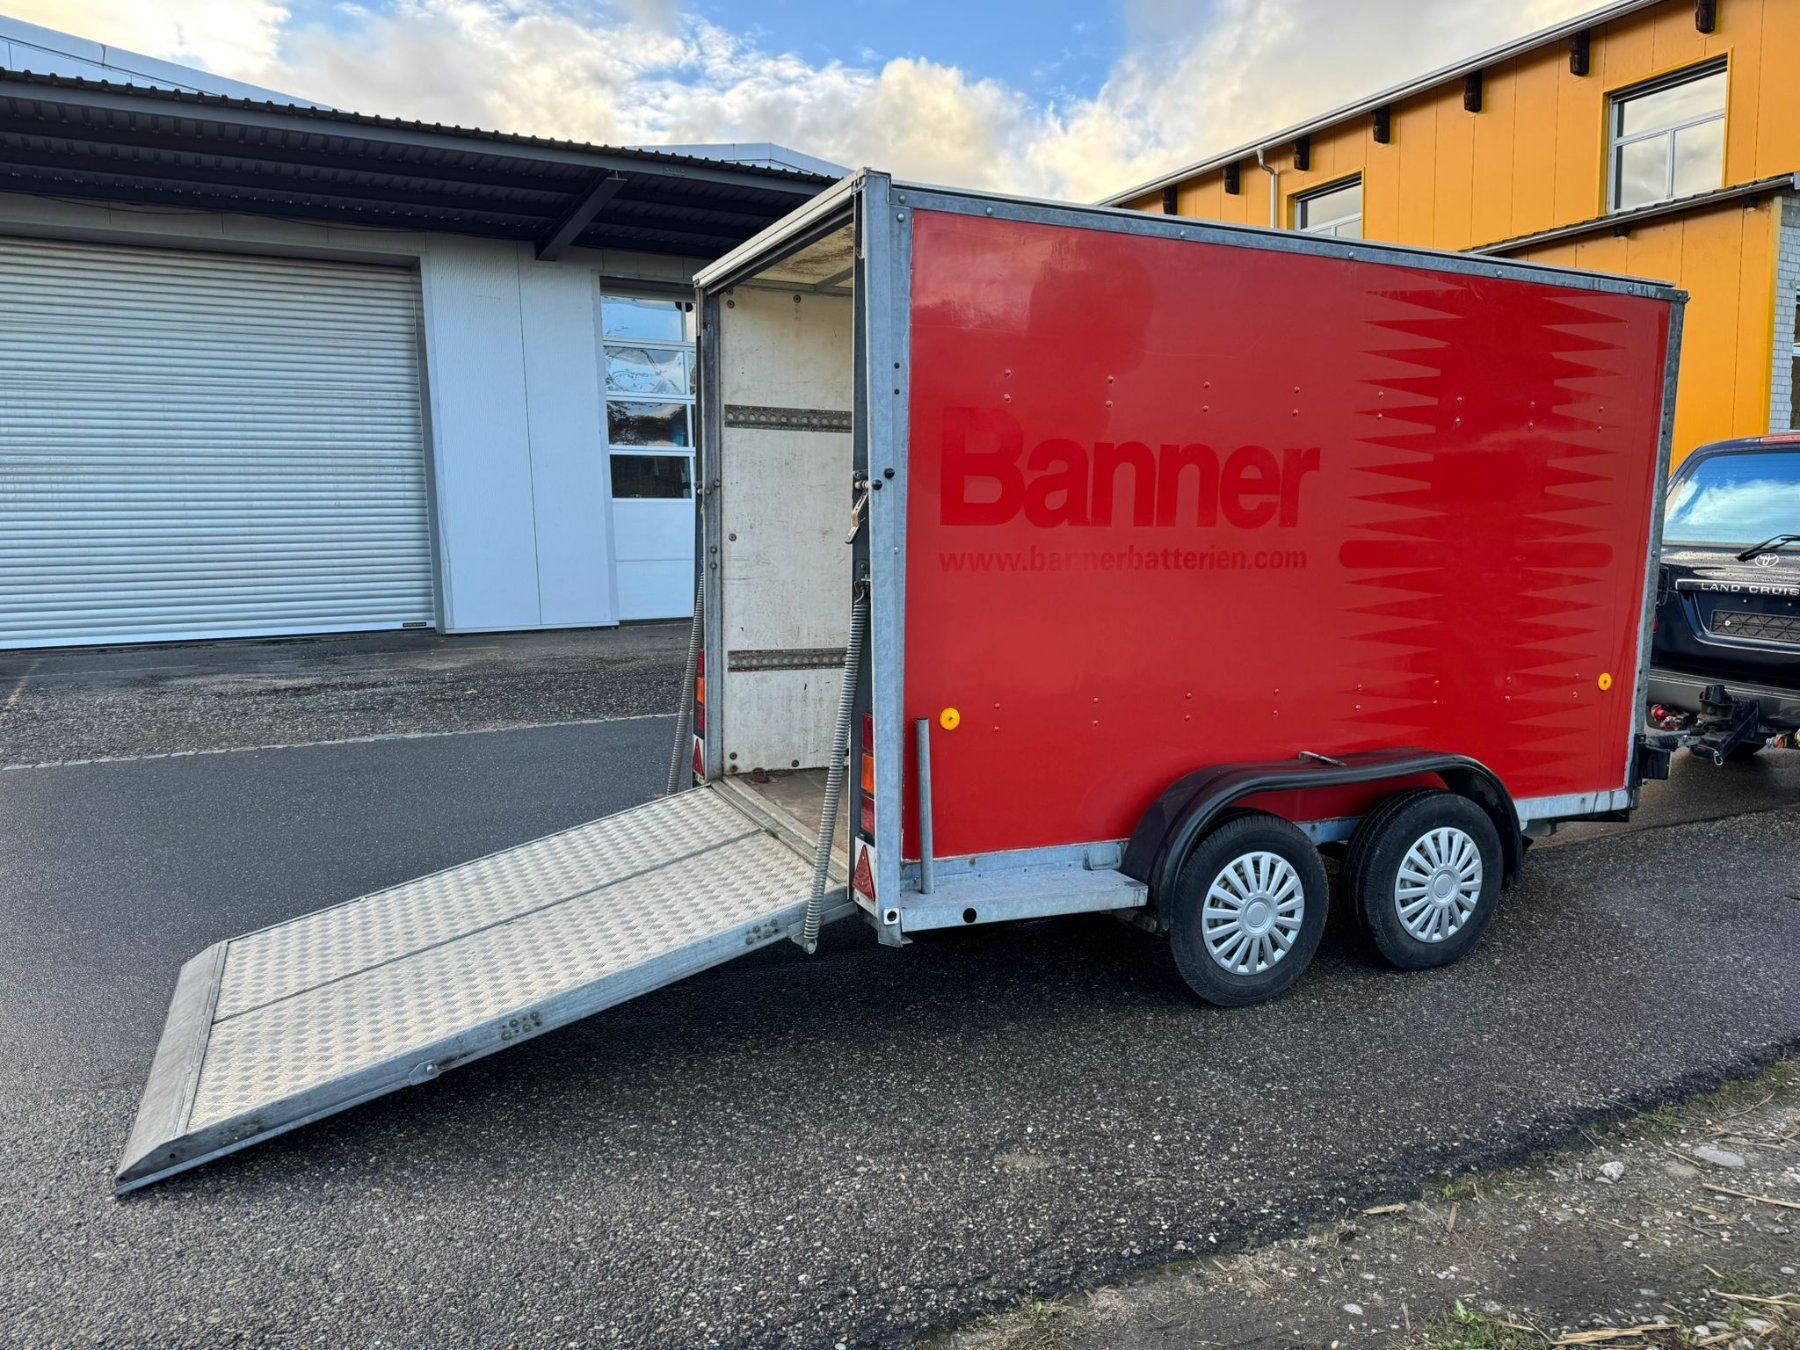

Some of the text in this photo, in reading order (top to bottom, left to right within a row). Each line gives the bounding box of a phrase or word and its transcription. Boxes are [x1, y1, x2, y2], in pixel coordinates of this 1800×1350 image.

[939, 406, 1321, 528] Banner
[938, 544, 1307, 572] www.bannerbatterien.com
[1701, 583, 1741, 592] LAND
